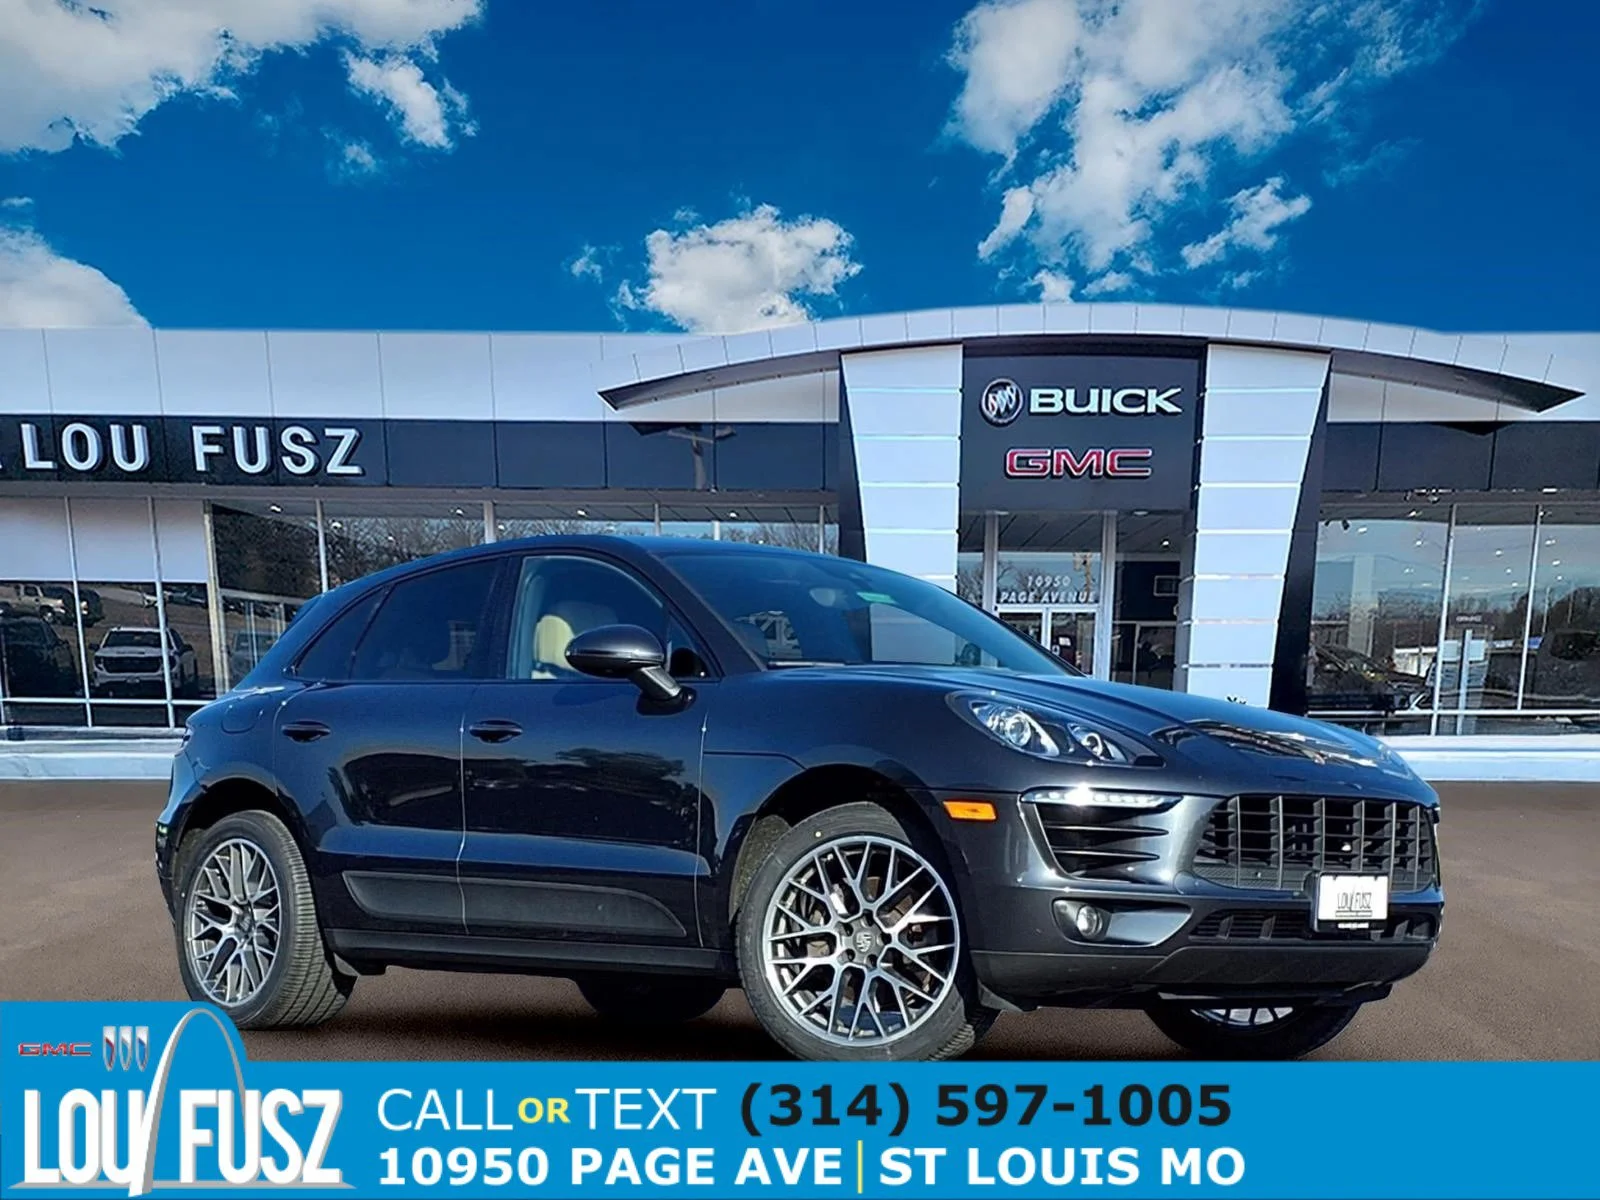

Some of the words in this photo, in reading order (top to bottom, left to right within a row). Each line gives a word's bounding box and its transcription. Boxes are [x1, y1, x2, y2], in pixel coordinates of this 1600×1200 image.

[1029, 387, 1183, 414] BUICK
[20, 422, 150, 472] LOU
[191, 424, 364, 475] FUSZ
[1006, 448, 1153, 476] GMC
[1027, 575, 1071, 587] 10950
[1000, 591, 1037, 603] PAGE
[1040, 591, 1096, 603] AVENUE
